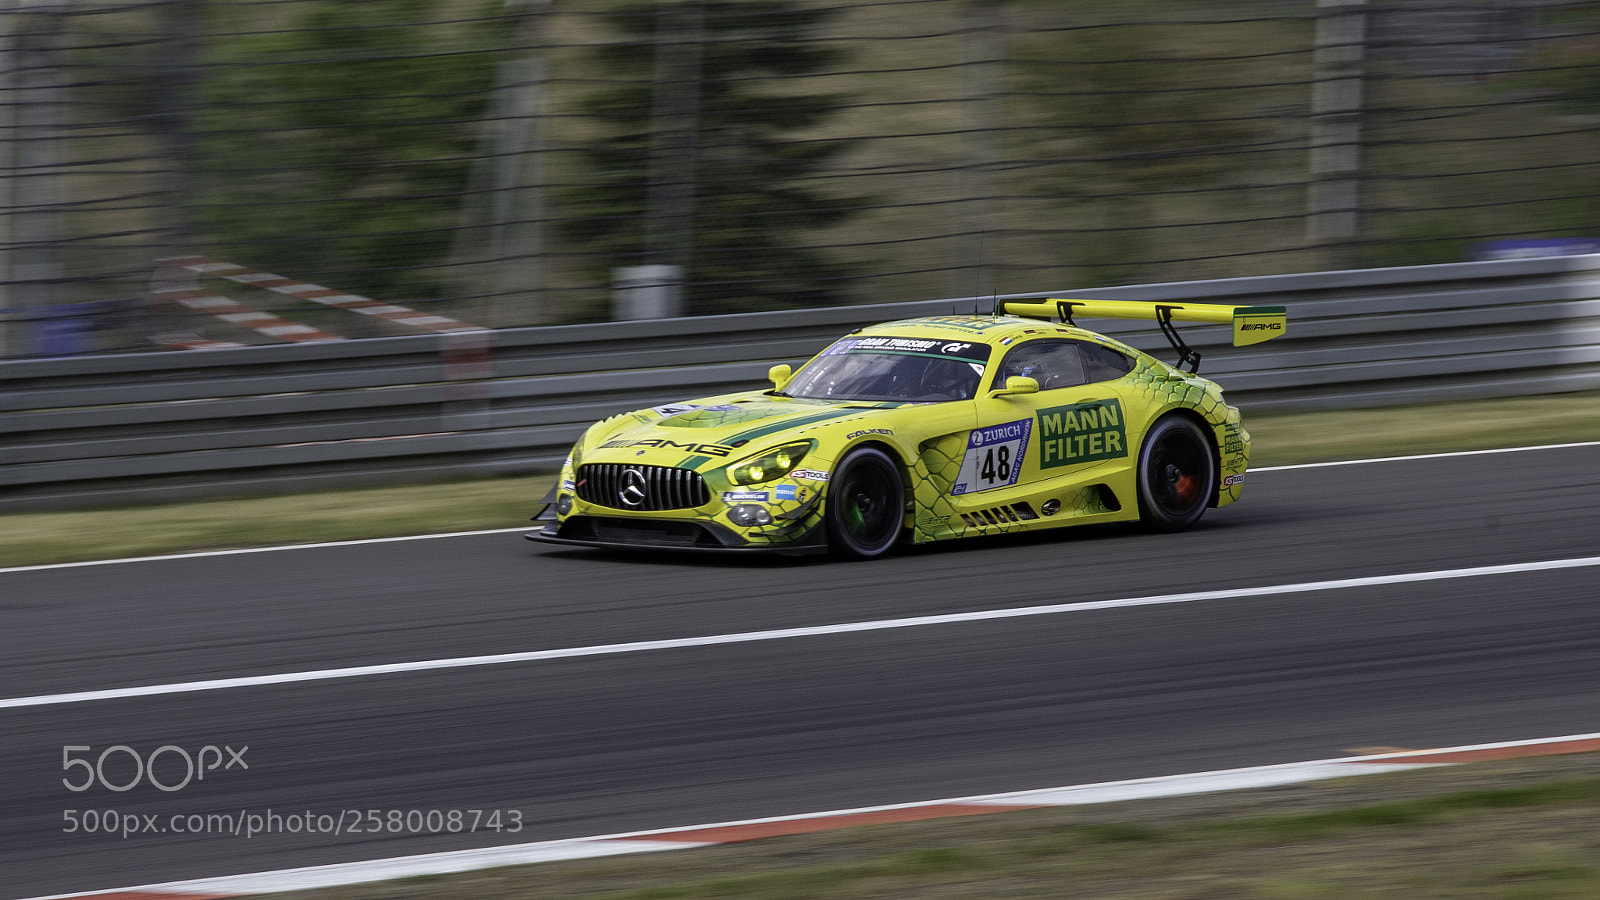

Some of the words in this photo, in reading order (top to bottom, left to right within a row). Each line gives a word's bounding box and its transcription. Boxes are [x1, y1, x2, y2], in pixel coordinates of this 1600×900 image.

[1254, 322, 1282, 331] AMG
[857, 338, 890, 346] GRAN
[1042, 404, 1119, 437] MANN
[846, 428, 894, 440] FALKEN
[984, 425, 1021, 442] ZURICH
[628, 439, 733, 457] AMG
[1011, 463, 1020, 483] ADAC
[1017, 420, 1031, 462] NORDRHEIN
[1044, 430, 1122, 463] FILTER
[981, 445, 1011, 484] 48
[806, 472, 830, 480] TOOLS
